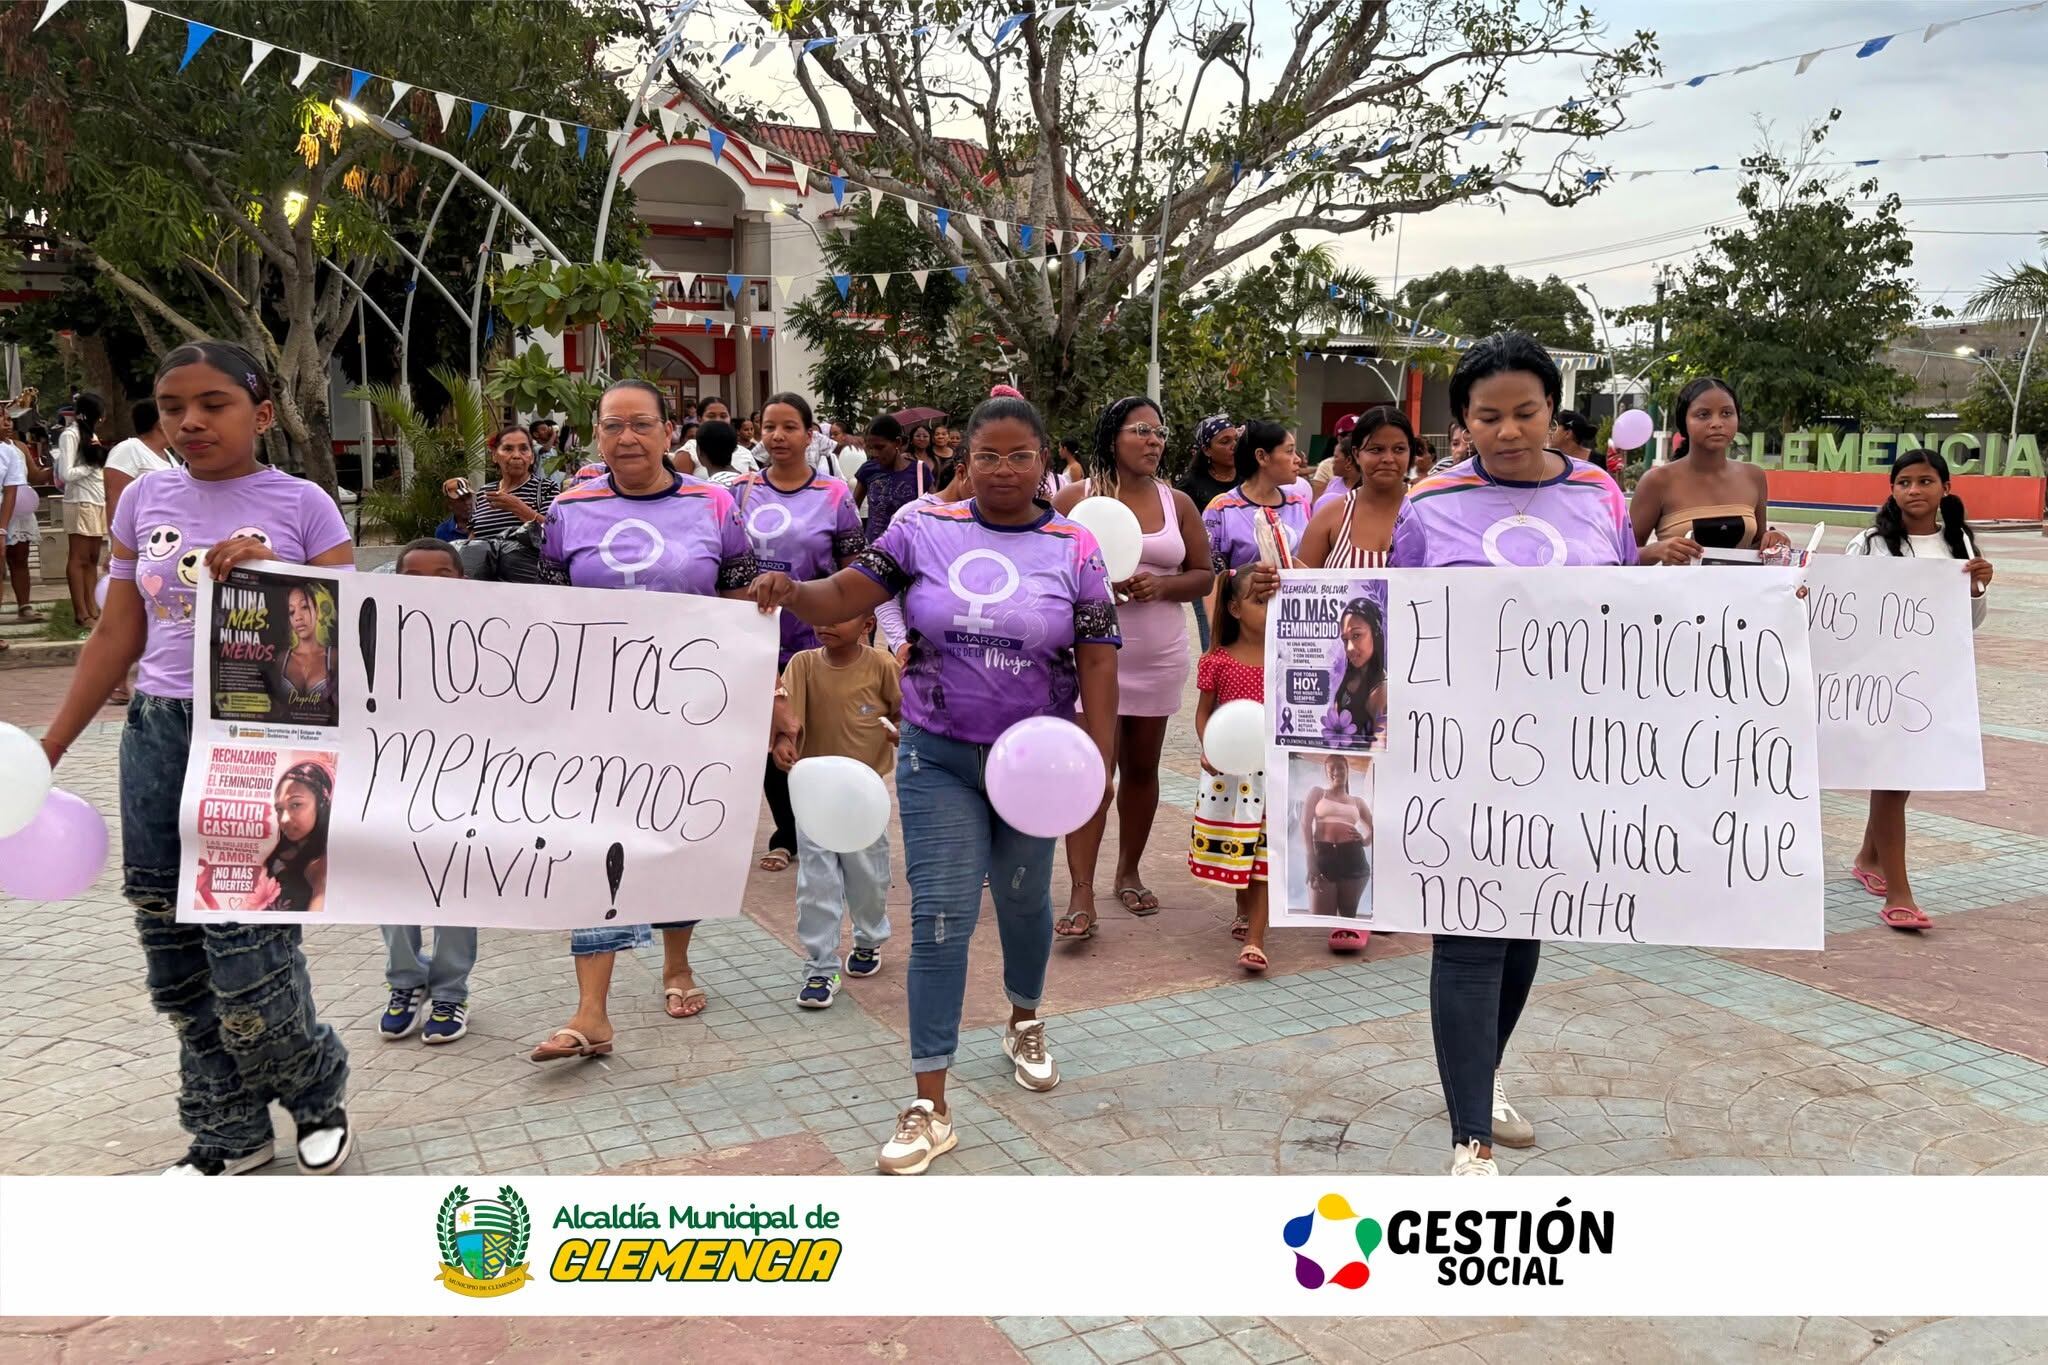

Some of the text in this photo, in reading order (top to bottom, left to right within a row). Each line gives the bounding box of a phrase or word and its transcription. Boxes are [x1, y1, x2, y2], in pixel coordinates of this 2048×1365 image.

[221, 586, 266, 612] NI UNA
[1282, 596, 1338, 621] NO MÁS
[1804, 580, 1934, 640] vas nos
[220, 628, 261, 646] NI UNA
[956, 633, 1011, 646] MARZO
[1280, 622, 1338, 638] FEMINICIDIO
[1407, 586, 1790, 707] El feminicidio
[963, 648, 974, 658] DE
[985, 647, 1036, 675] Mujer
[212, 748, 277, 766] RECHAZAMOS
[1408, 710, 1808, 800] no es una cifra
[210, 764, 274, 777] PROFUNDAMENTE
[207, 775, 273, 790] EL FEMINICIDIO
[361, 728, 732, 842] merecemos
[204, 801, 264, 821] DEYALITH
[203, 819, 264, 838] CASTAÑO
[1403, 796, 1450, 868] es
[1470, 802, 1559, 869] una
[1712, 811, 1804, 887] que
[207, 851, 256, 864] Y AMOR.
[212, 867, 229, 880] ¡NO
[211, 878, 253, 891] MUERTES!
[1410, 872, 1646, 943] nos falta
